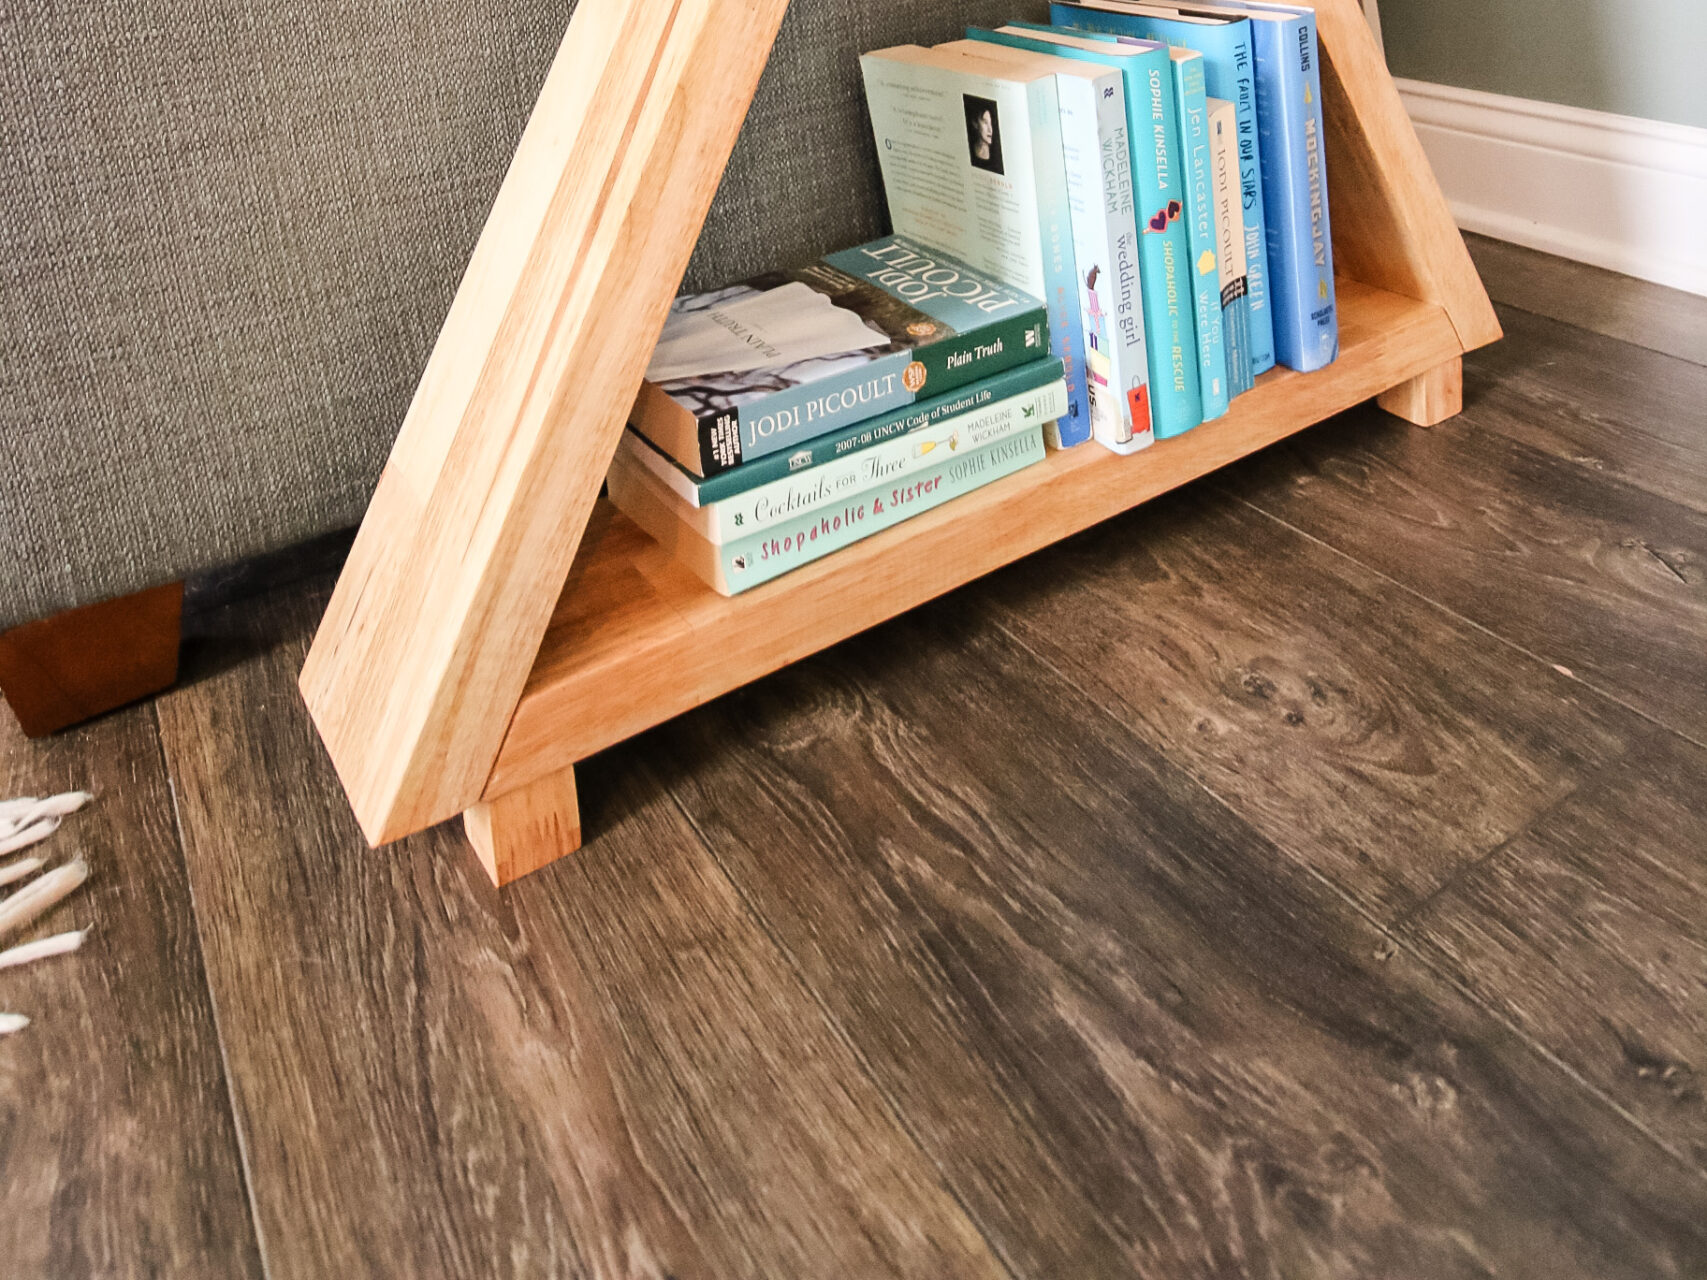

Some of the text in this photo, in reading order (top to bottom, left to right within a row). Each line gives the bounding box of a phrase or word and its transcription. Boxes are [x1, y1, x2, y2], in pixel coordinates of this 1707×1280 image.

[1149, 69, 1164, 121] SOPHIE
[1188, 107, 1203, 137] Jen
[1101, 138, 1118, 214] WICKHAM
[1114, 126, 1132, 215] MADELEINE
[1153, 124, 1169, 190] KINSELLA
[1216, 148, 1228, 193] JODI
[1234, 41, 1266, 312] THE FAULT IN OUR STARS JOHN GREEN
[1298, 26, 1326, 267] COLLINS MOCKINGJAY
[1193, 144, 1210, 239] Lancaster
[1220, 197, 1235, 277] PICOULT
[861, 243, 1019, 313] PICOULT
[867, 267, 948, 304] JODI
[1116, 234, 1141, 347] wedding girl
[1162, 239, 1178, 317] SHOPAHOLIC
[707, 311, 783, 359] PLAIN TRUTH
[946, 337, 1004, 370] Plain Truth
[1197, 290, 1212, 368] Were Here
[1211, 314, 1224, 345] You
[1172, 345, 1185, 393] RESCUE
[716, 417, 728, 467] YORK TIMES
[731, 419, 742, 455] AUTHOR
[748, 373, 896, 447] JODI PICOULT
[835, 389, 992, 454] 2007-08 UNCW Code of Student Life
[967, 408, 1013, 431] MADELEINE
[971, 422, 1012, 444] WICKHAM
[754, 454, 907, 522] Cocktails FOR Three
[872, 497, 884, 515] &
[949, 456, 985, 484] SOPHIE
[990, 434, 1038, 465] KINSELLA
